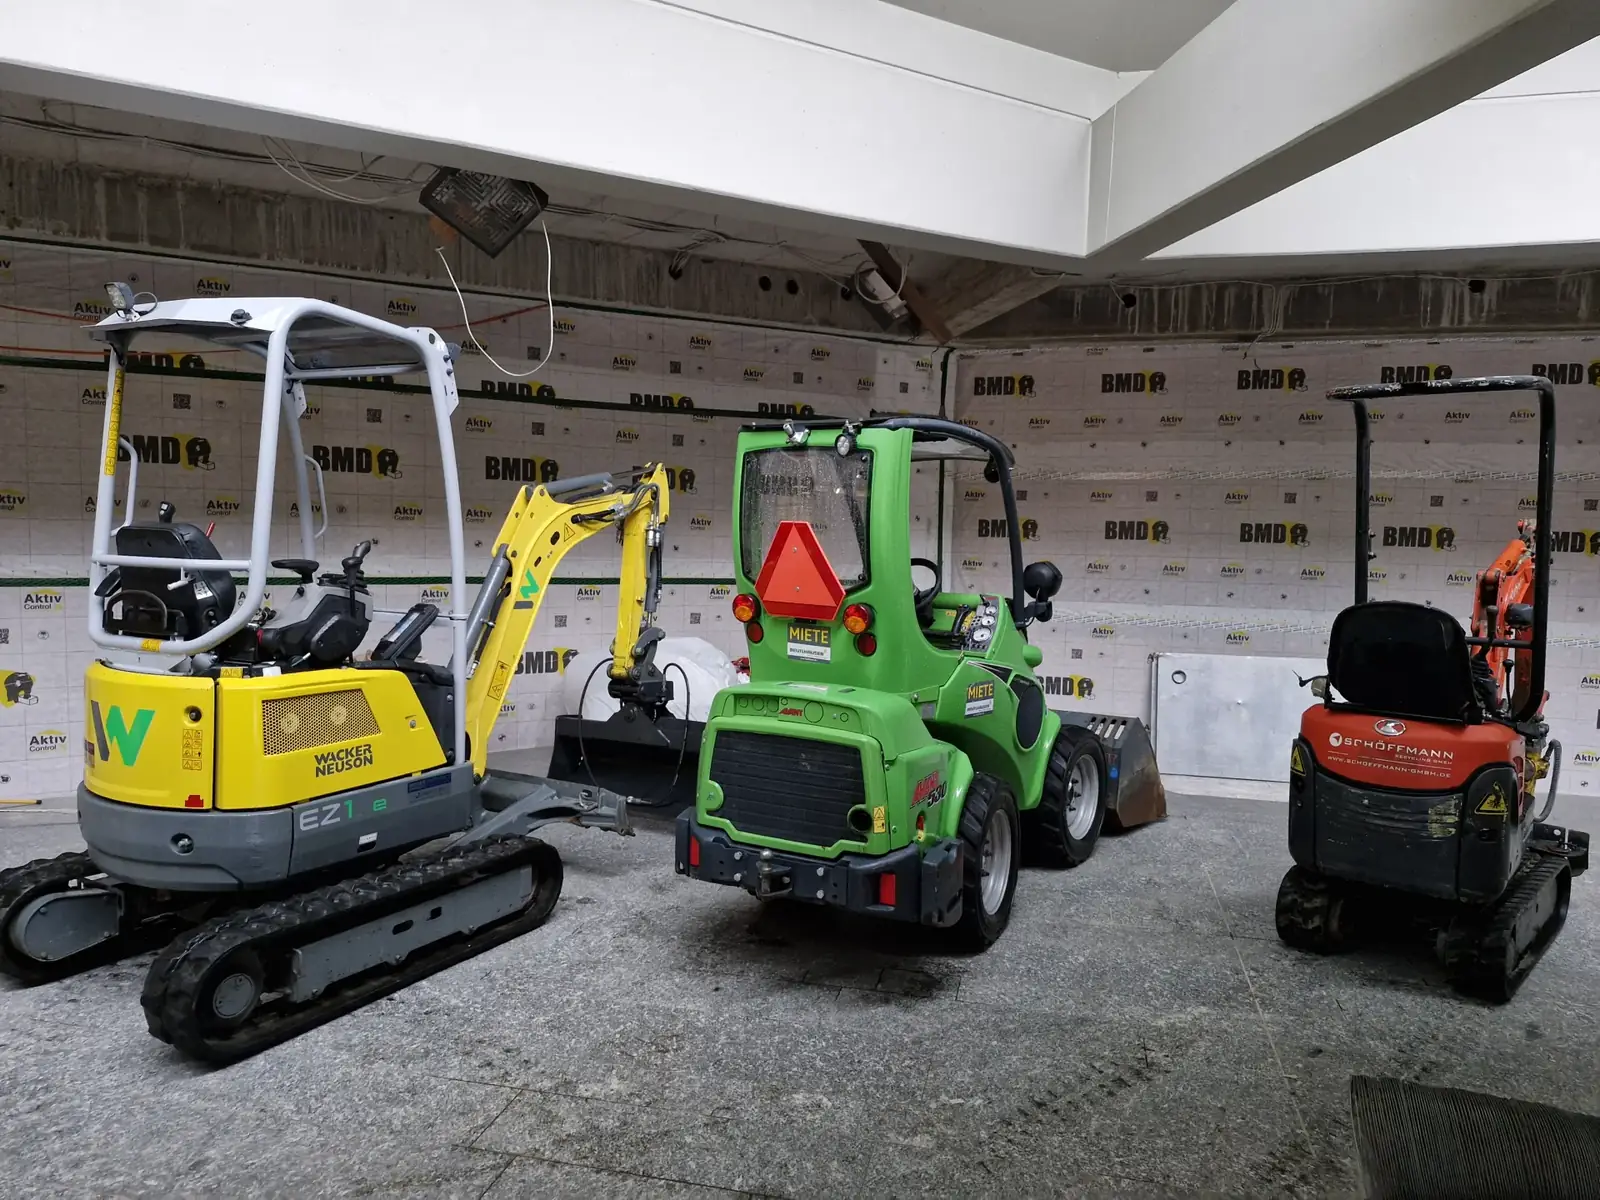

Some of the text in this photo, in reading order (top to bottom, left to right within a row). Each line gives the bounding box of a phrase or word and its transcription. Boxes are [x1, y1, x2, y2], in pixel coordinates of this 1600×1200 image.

[196, 278, 230, 292] Aktiv
[74, 302, 112, 315] Aktiv
[388, 300, 416, 312] Aktiv
[552, 320, 575, 331] Aktiv
[461, 340, 488, 352] Aktiv
[690, 337, 712, 346] Aktiv
[811, 349, 830, 358] Aktiv
[613, 357, 636, 366] Aktiv
[916, 361, 933, 370] Aktiv
[744, 369, 764, 378] Aktiv
[1381, 366, 1430, 383] BMD
[1532, 364, 1583, 384] BMD
[974, 376, 1016, 396] BMD
[1102, 373, 1146, 393] BMD
[1237, 370, 1284, 390] BMD
[82, 388, 106, 399] Akt
[466, 418, 492, 428] Aktiv
[1084, 417, 1106, 425] Aktiv
[616, 431, 639, 440] Aktiv
[313, 446, 372, 472] BMD
[486, 456, 536, 482] BMD
[0, 495, 25, 504] ktiv
[206, 500, 240, 510] Aktiv
[394, 506, 423, 516] Aktiv
[466, 509, 492, 518] Aktiv
[978, 520, 1009, 538] BM
[1105, 520, 1148, 540] BMD
[1240, 524, 1286, 543] BMD
[1383, 526, 1432, 548] BMD
[1551, 532, 1586, 552] MD
[422, 590, 449, 598] Aktiv
[577, 588, 600, 596] Aktiv
[710, 588, 730, 596] Aktiv
[24, 594, 62, 603] Aktiv
[790, 626, 828, 644] MIETE
[968, 684, 993, 700] MIETE
[30, 736, 66, 746] Aktiv
[1344, 738, 1454, 759] SCHÖFFMANN
[314, 744, 372, 766] WACKER
[316, 754, 373, 778] NEUSON
[300, 800, 352, 831] EZ1
